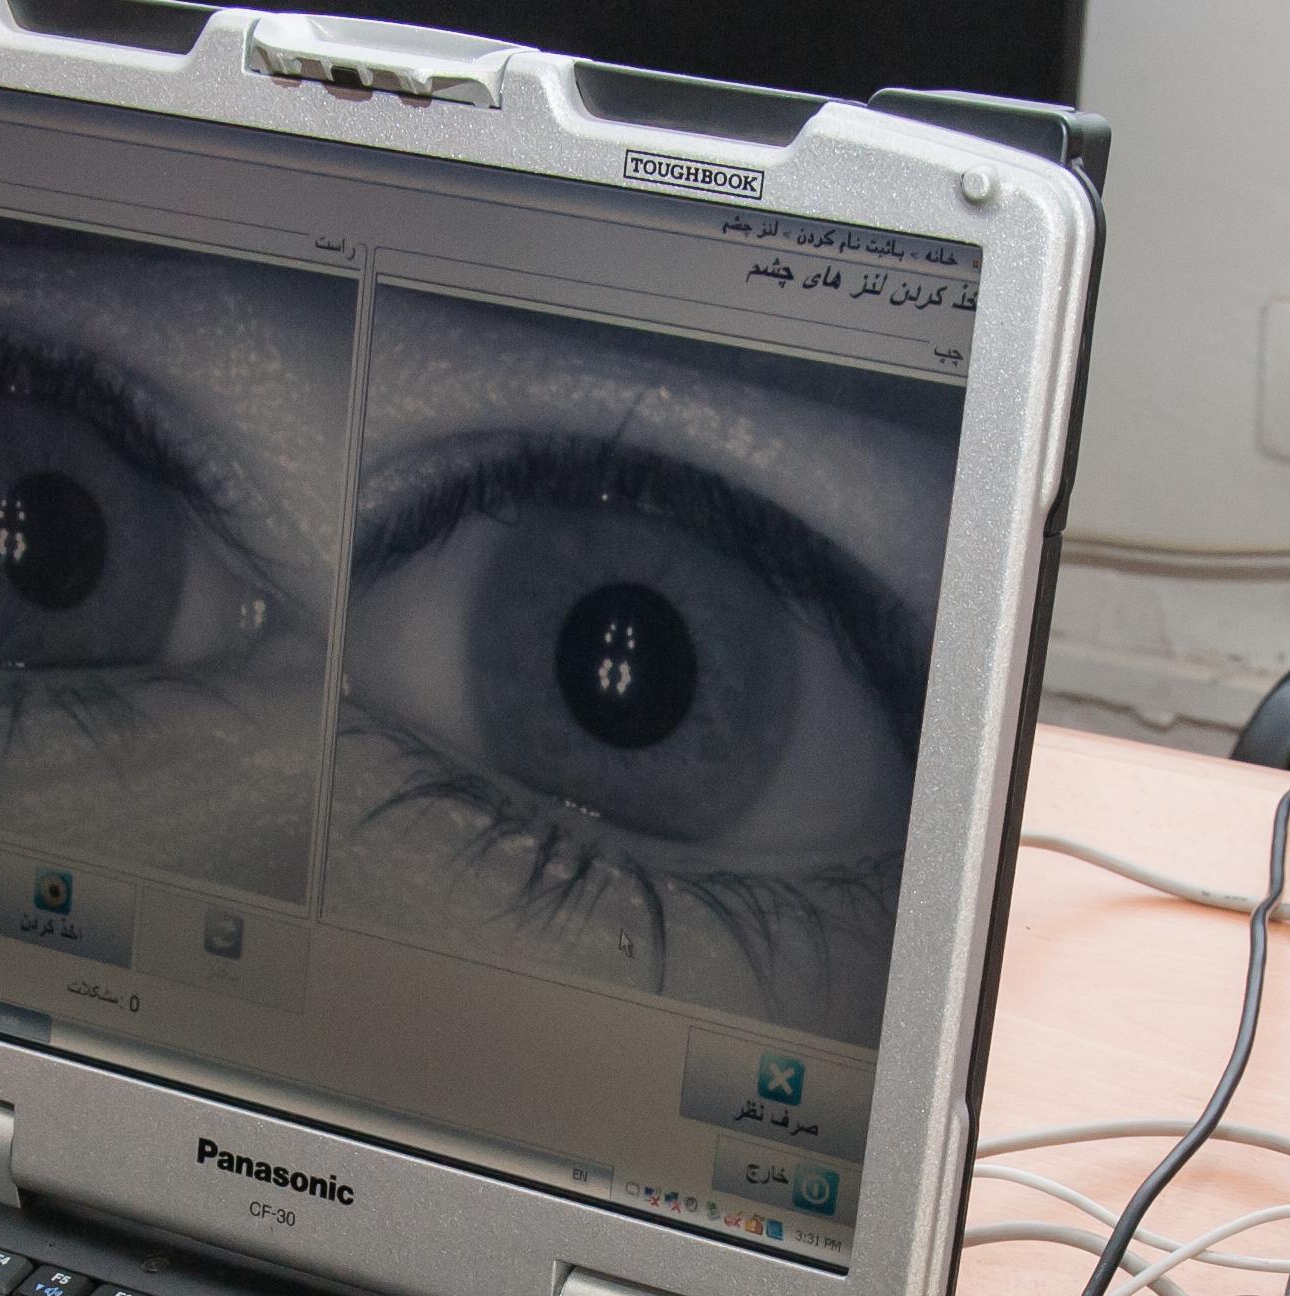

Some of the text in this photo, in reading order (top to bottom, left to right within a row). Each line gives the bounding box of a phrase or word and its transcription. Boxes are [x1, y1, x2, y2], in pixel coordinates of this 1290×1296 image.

[630, 156, 758, 192] TOUGHBOOK
[757, 219, 779, 238] لنز
[840, 231, 860, 252] نام
[747, 258, 794, 288] چشم
[803, 266, 841, 290] های
[851, 274, 887, 298] لنز
[952, 284, 978, 311] خذ
[197, 1137, 354, 1205] Panasonic
[573, 1168, 588, 1181] EN
[250, 1201, 295, 1226] CF-30
[824, 1238, 843, 1253] PM
[51, 1273, 71, 1284] F5
